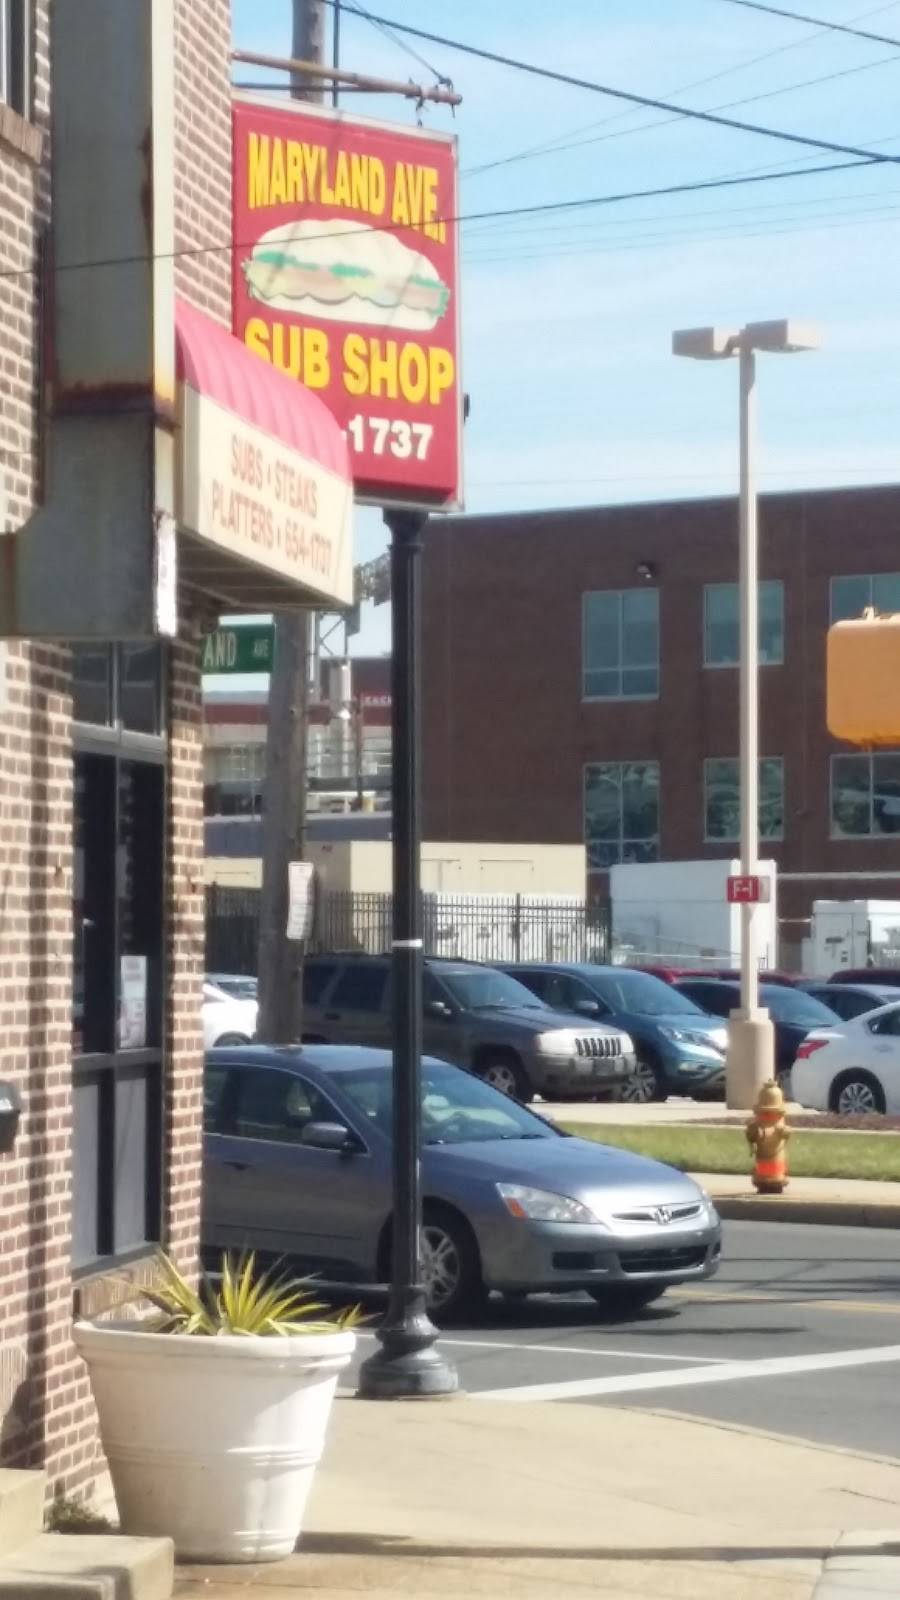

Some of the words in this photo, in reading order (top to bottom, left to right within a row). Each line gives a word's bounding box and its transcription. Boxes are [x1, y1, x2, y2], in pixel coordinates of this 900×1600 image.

[248, 131, 386, 216] MARYLAND
[392, 161, 446, 244] AVE.
[245, 318, 330, 388] SUB
[342, 332, 454, 405] SHOP
[212, 478, 273, 549] PLATTERS
[231, 433, 263, 491] SUBS
[274, 459, 318, 520] STEAKS
